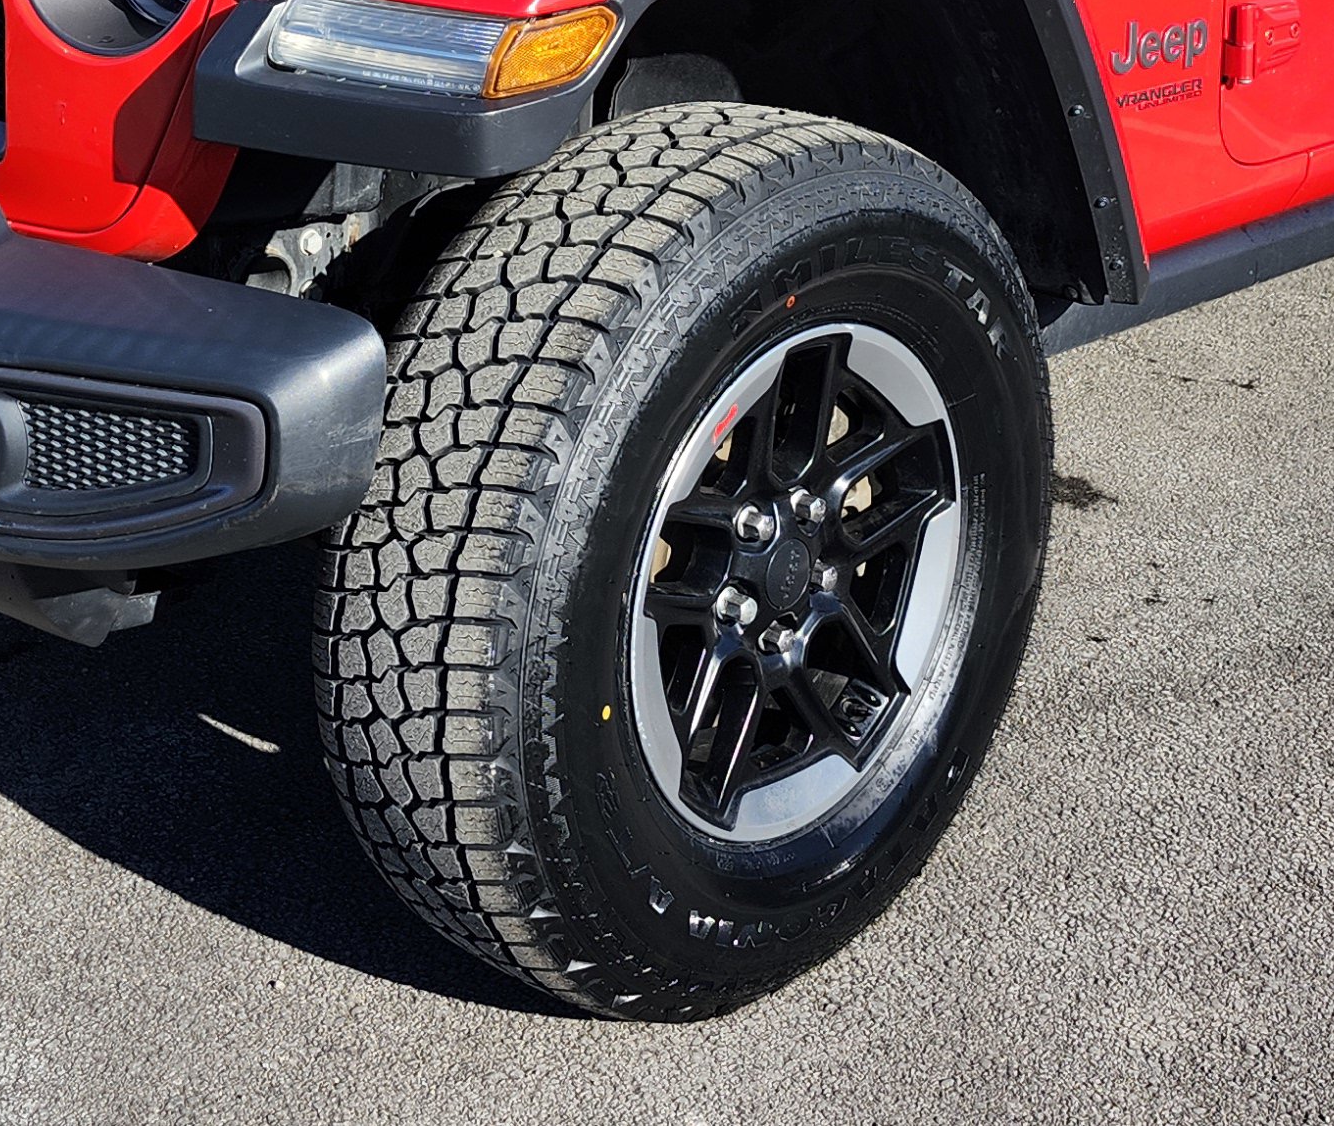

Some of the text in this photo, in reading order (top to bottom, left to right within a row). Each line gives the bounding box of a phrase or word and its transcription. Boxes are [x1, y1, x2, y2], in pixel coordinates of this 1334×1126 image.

[1110, 19, 1208, 75] Jeep
[1116, 78, 1203, 108] WRANGLER
[771, 235, 1011, 361] MILESTAR
